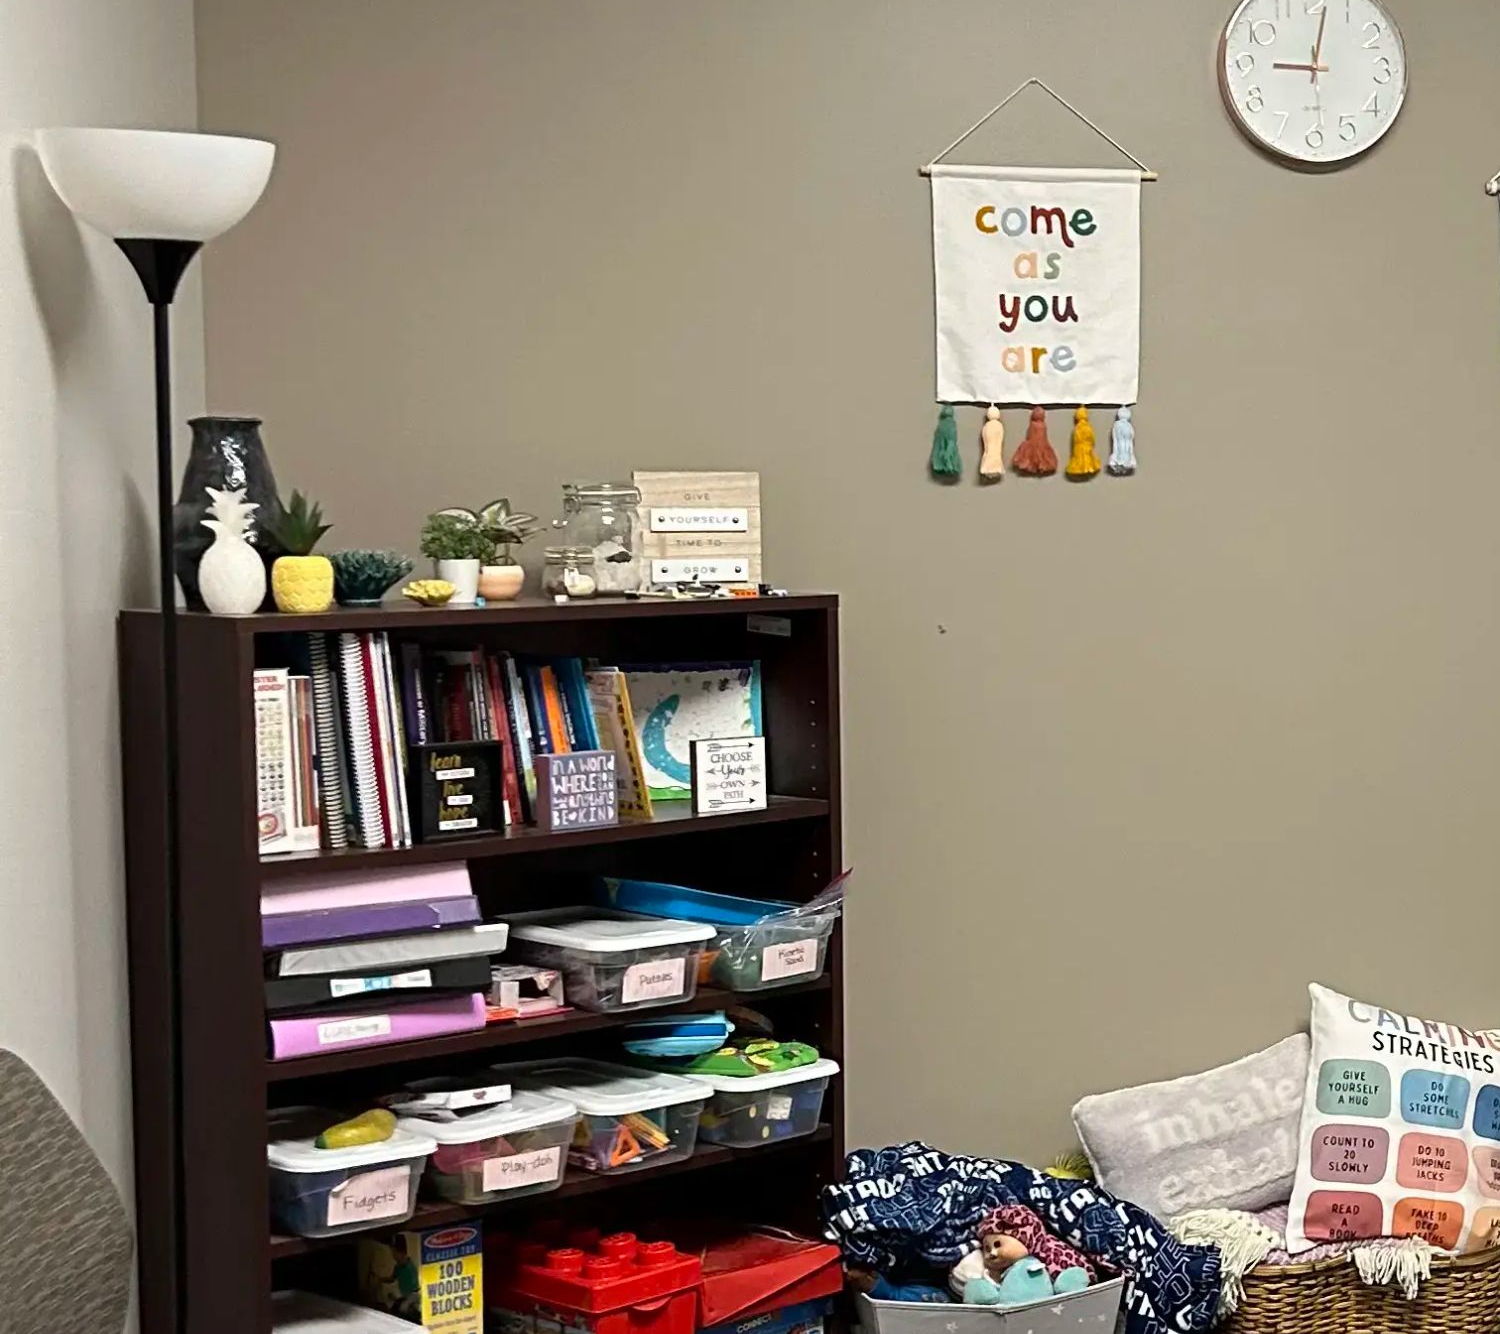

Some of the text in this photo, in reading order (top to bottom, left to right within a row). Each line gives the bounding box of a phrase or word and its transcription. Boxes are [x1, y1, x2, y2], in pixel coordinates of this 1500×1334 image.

[1240, 18, 1276, 46] 10
[1362, 21, 1382, 49] 2
[1236, 51, 1255, 77] 9
[1373, 56, 1392, 85] 3
[1246, 85, 1264, 113] 8
[1362, 91, 1381, 118] 4
[1273, 111, 1289, 138] 7
[1338, 114, 1357, 142] 5
[1305, 122, 1324, 149] 6
[975, 205, 1097, 248] come
[1013, 251, 1062, 280] as
[998, 294, 1079, 333] you
[1001, 345, 1077, 374] are
[683, 493, 710, 502] GIVE
[669, 514, 729, 525] YOURSELF
[676, 539, 722, 547] TIME TO
[683, 566, 718, 575] GROW
[711, 751, 753, 763] CHOOSE
[551, 773, 597, 795] WHERE
[720, 780, 746, 789] OWN
[724, 790, 744, 799] PATH
[578, 805, 615, 824] KIND
[1372, 1030, 1495, 1073] STRATEGIES
[1343, 1070, 1366, 1081] GIVE
[1328, 1082, 1380, 1094] YOURSELF
[1431, 1081, 1444, 1092] DO
[1338, 1096, 1368, 1106] A HUG
[1424, 1092, 1449, 1104] SOME
[1409, 1102, 1460, 1119] STRETCHES
[1323, 1136, 1375, 1149] COUNT TO
[1343, 1150, 1356, 1160] 20
[1418, 1145, 1445, 1157] DO 10
[1328, 1162, 1369, 1173] SLOWLY
[1412, 1157, 1452, 1170] JUMPING
[1416, 1169, 1445, 1182] JACKS
[343, 1190, 397, 1213] Fidgets
[1331, 1203, 1360, 1215] READ
[1411, 1208, 1447, 1222] TAKE 10
[1341, 1218, 1348, 1227] A
[1415, 1220, 1439, 1232] DEEP
[439, 1261, 462, 1279] 100
[427, 1275, 475, 1300] WOODEN
[431, 1294, 473, 1317] BLOCKS
